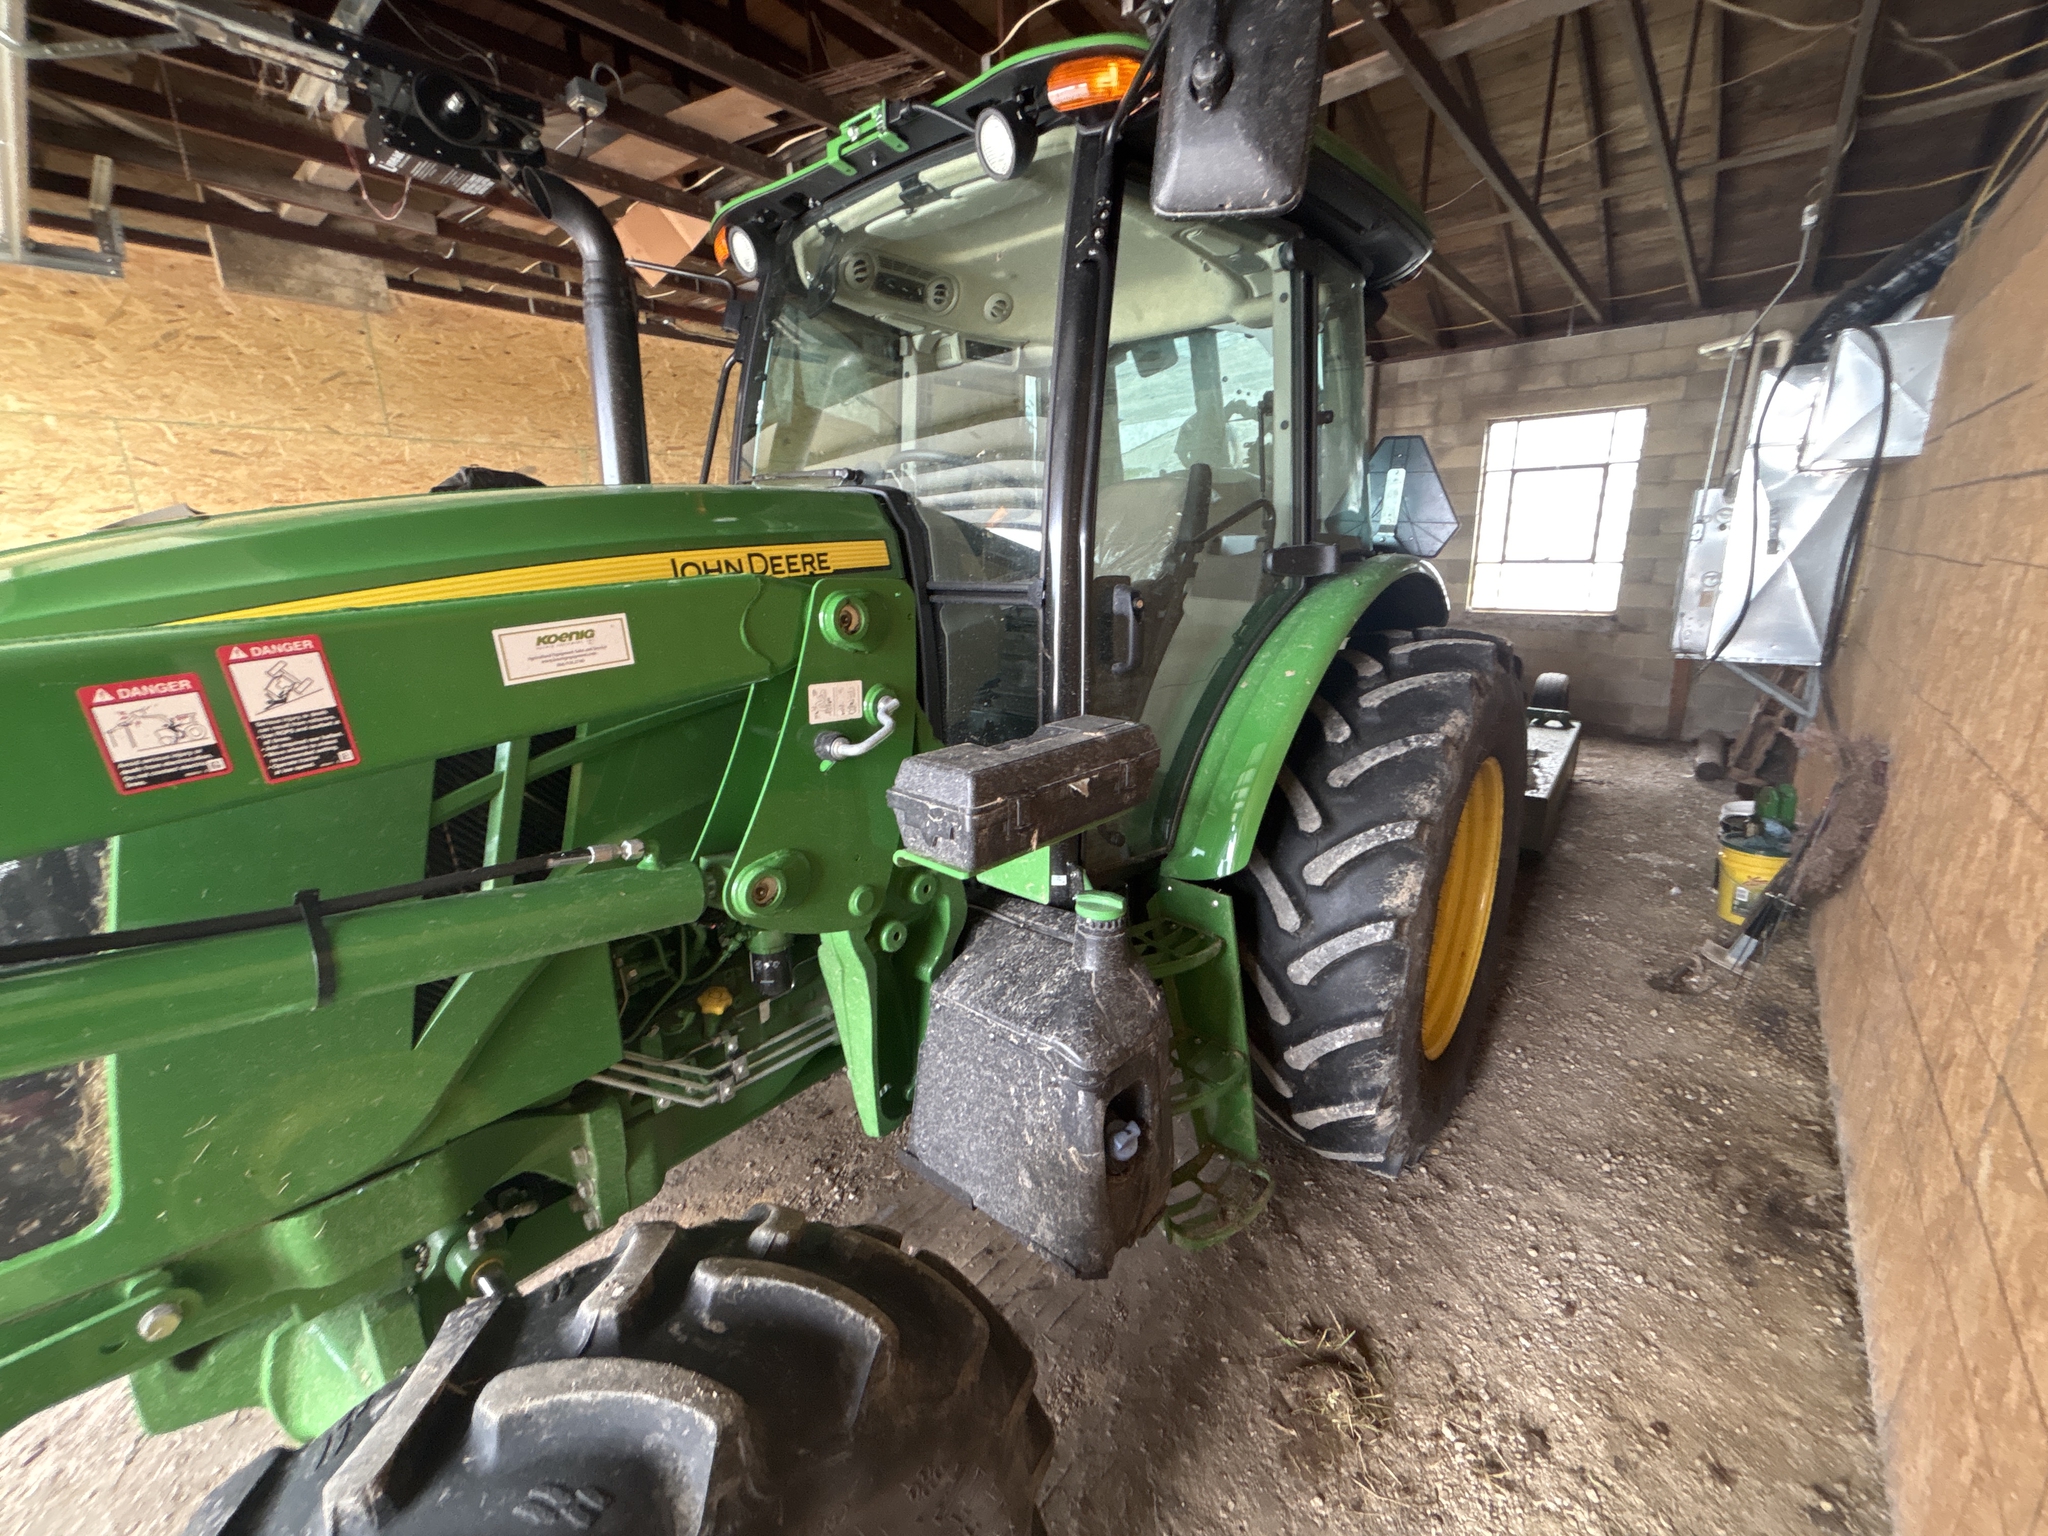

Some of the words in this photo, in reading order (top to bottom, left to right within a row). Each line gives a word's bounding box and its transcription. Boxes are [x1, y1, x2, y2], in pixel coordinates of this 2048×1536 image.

[671, 557, 743, 578] JOHN
[747, 552, 831, 576] DEERE
[249, 639, 315, 657] DANGER
[116, 679, 193, 699] DANGER
